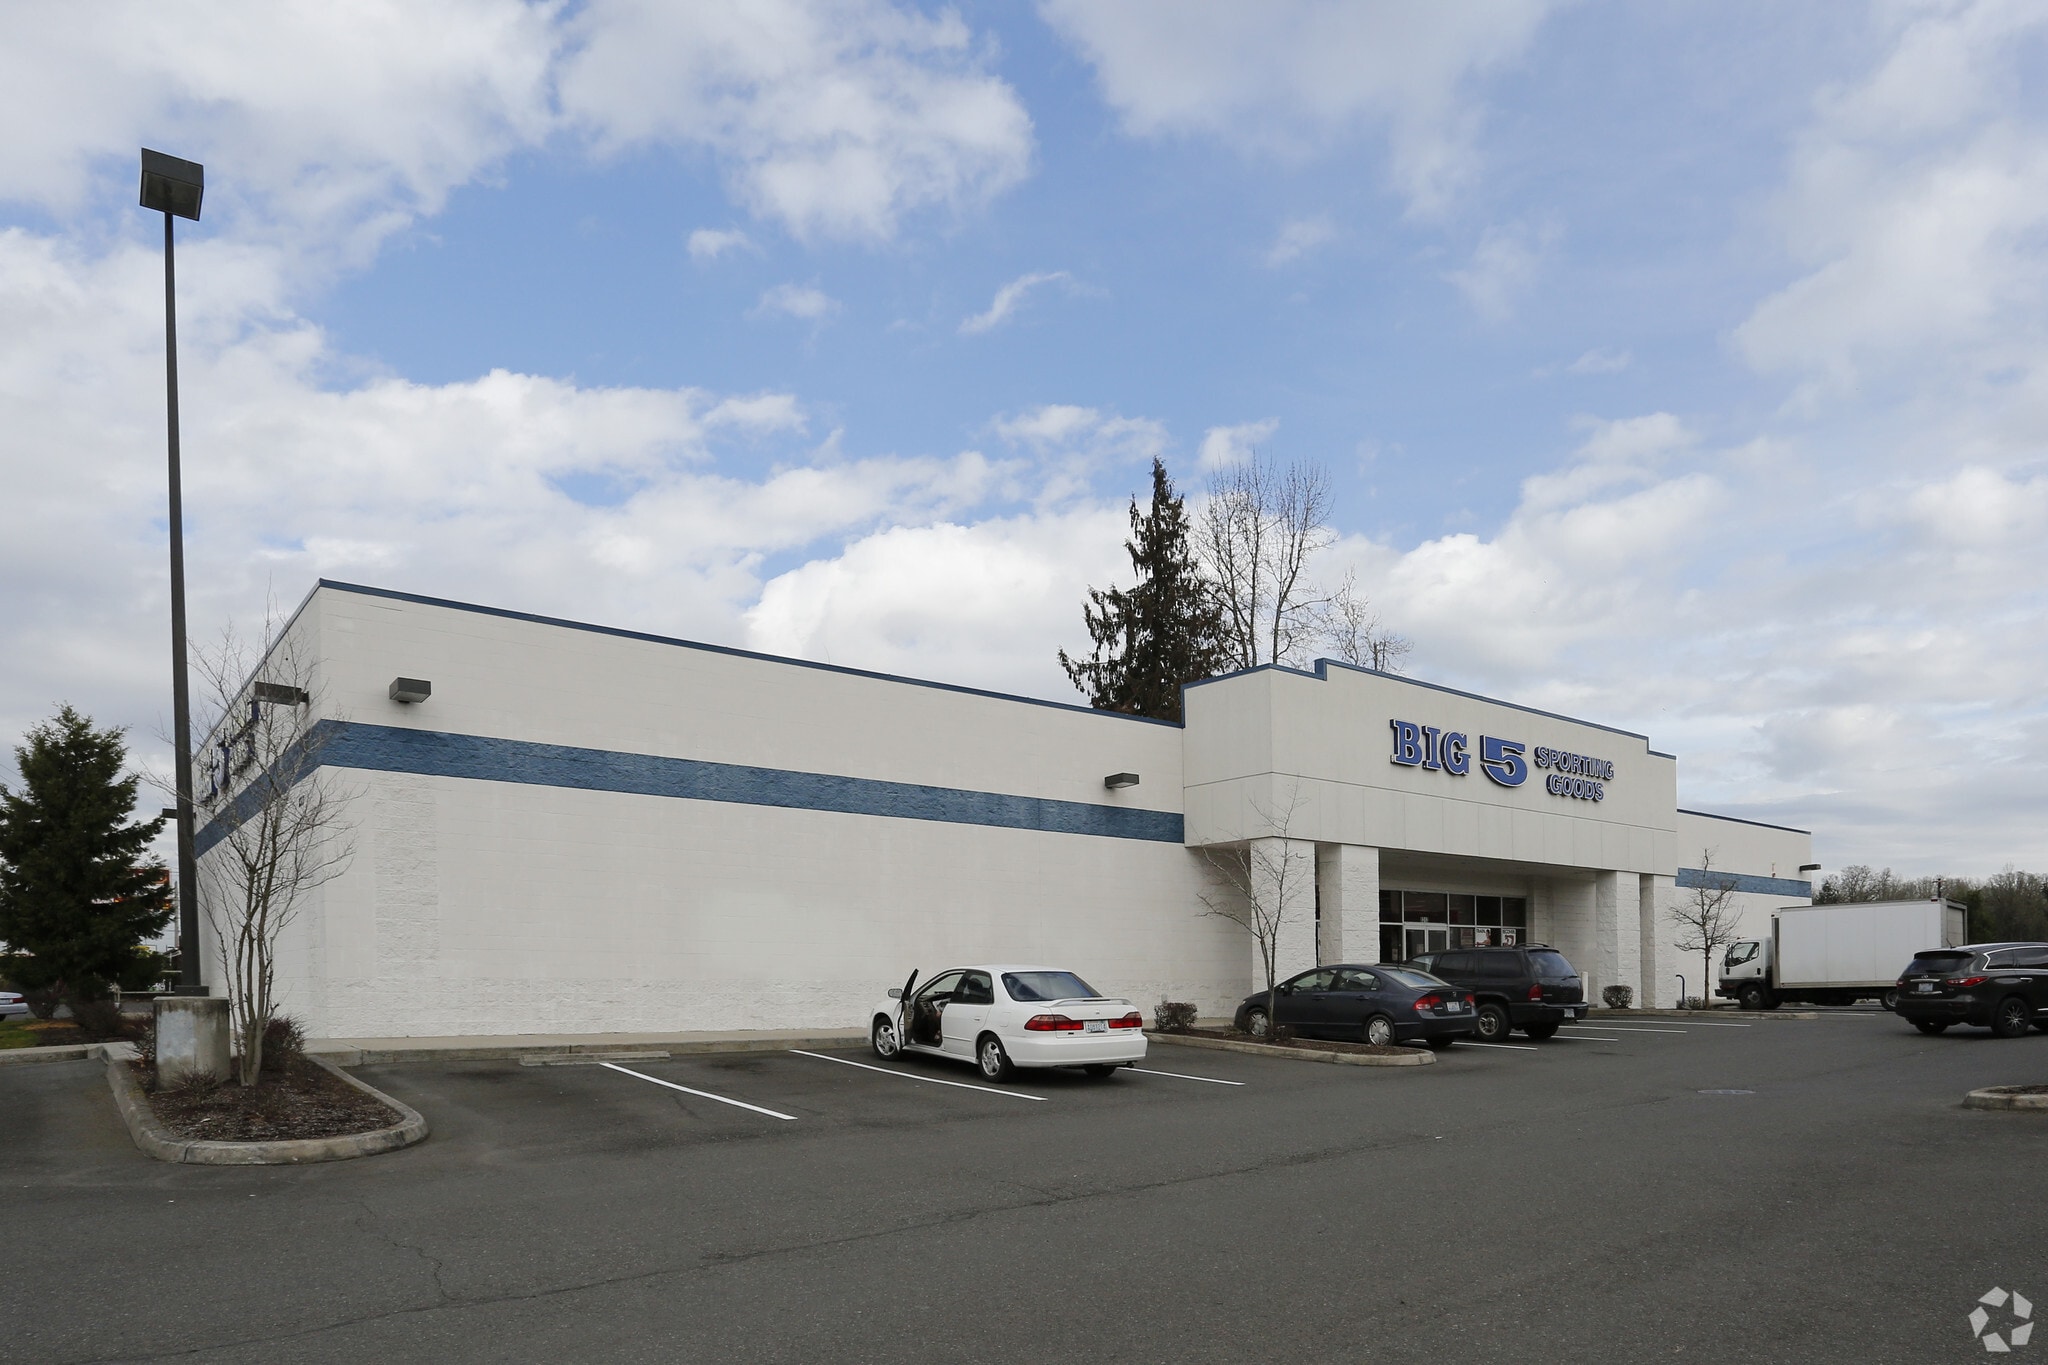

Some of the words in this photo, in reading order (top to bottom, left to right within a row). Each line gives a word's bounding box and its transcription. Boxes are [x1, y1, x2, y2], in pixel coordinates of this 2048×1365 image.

[1390, 719, 1471, 776] BIG
[1480, 735, 1528, 787] 5
[1535, 746, 1614, 780] SPORTING
[1547, 774, 1604, 802] GOODS
